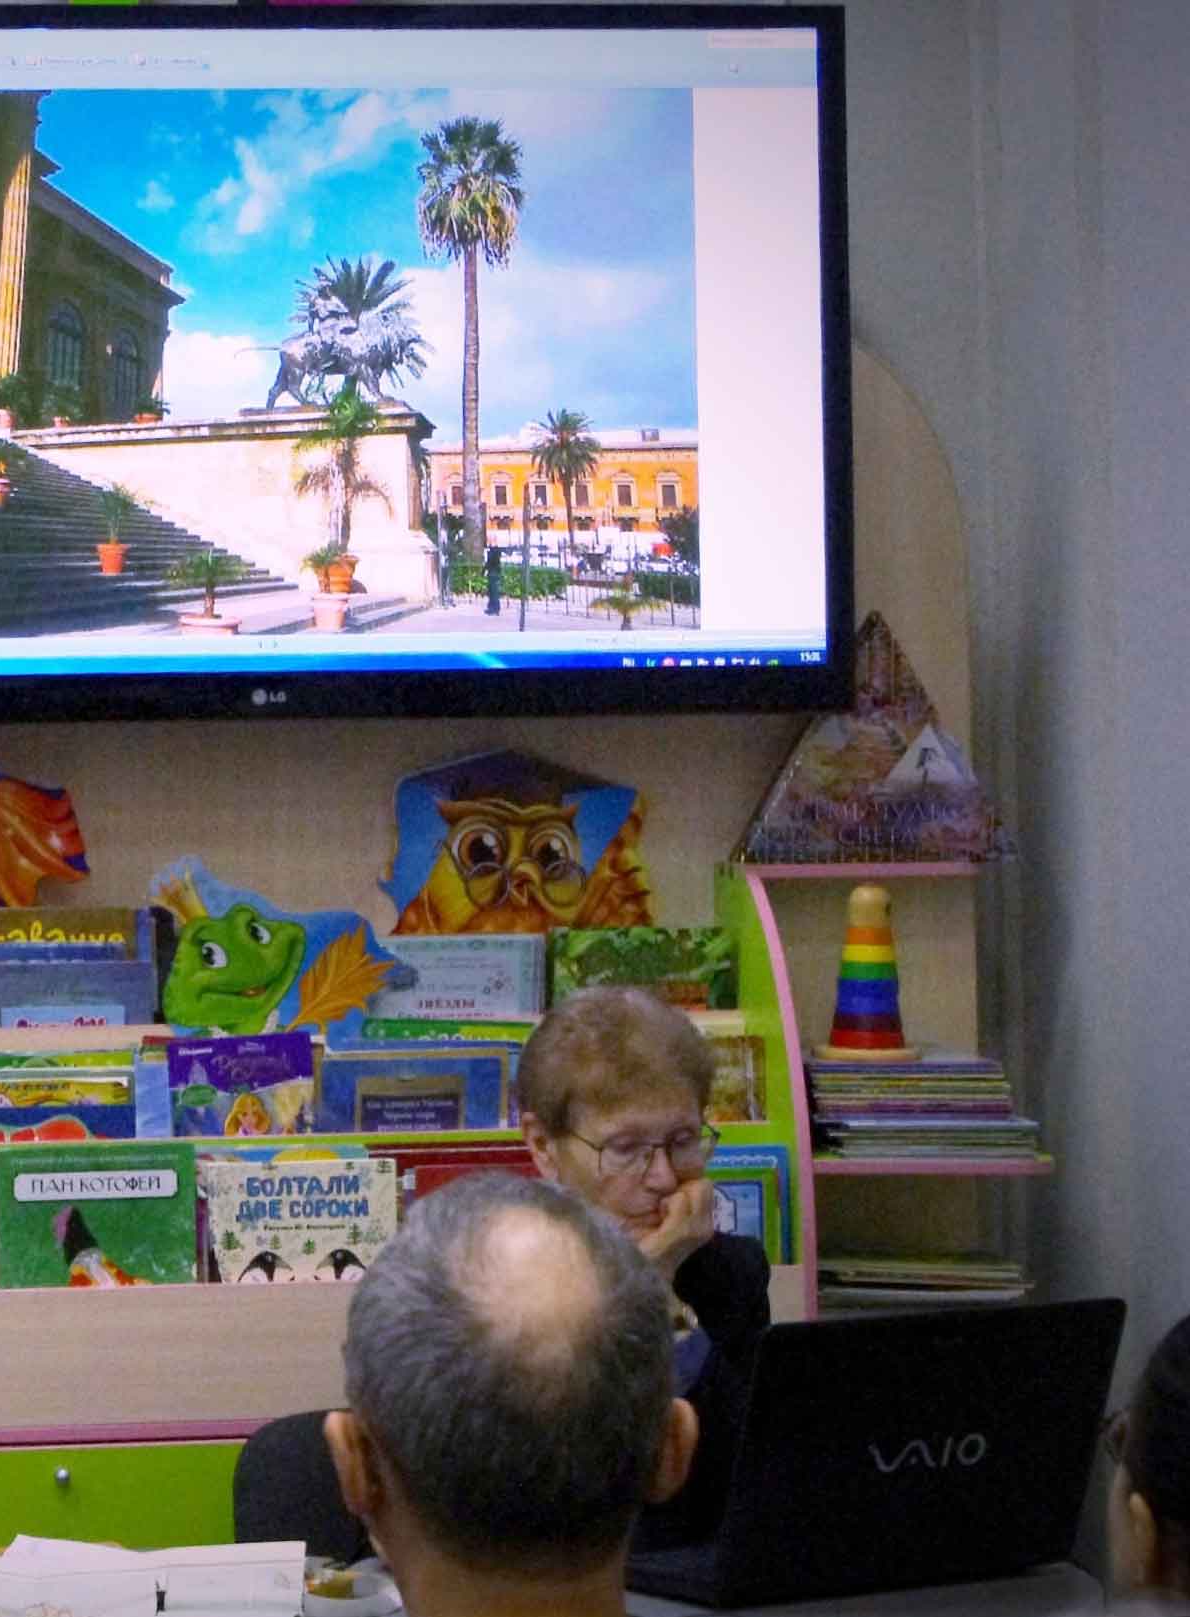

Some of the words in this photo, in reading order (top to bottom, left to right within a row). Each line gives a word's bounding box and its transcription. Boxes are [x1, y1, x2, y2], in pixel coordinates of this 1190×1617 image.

[30, 1178, 75, 1194] ПАН
[245, 1175, 360, 1197] БОЛТАЛИ
[235, 1198, 283, 1222] ДВЕ
[289, 1198, 370, 1218] СОРОКИ
[867, 1432, 988, 1473] VAIO
